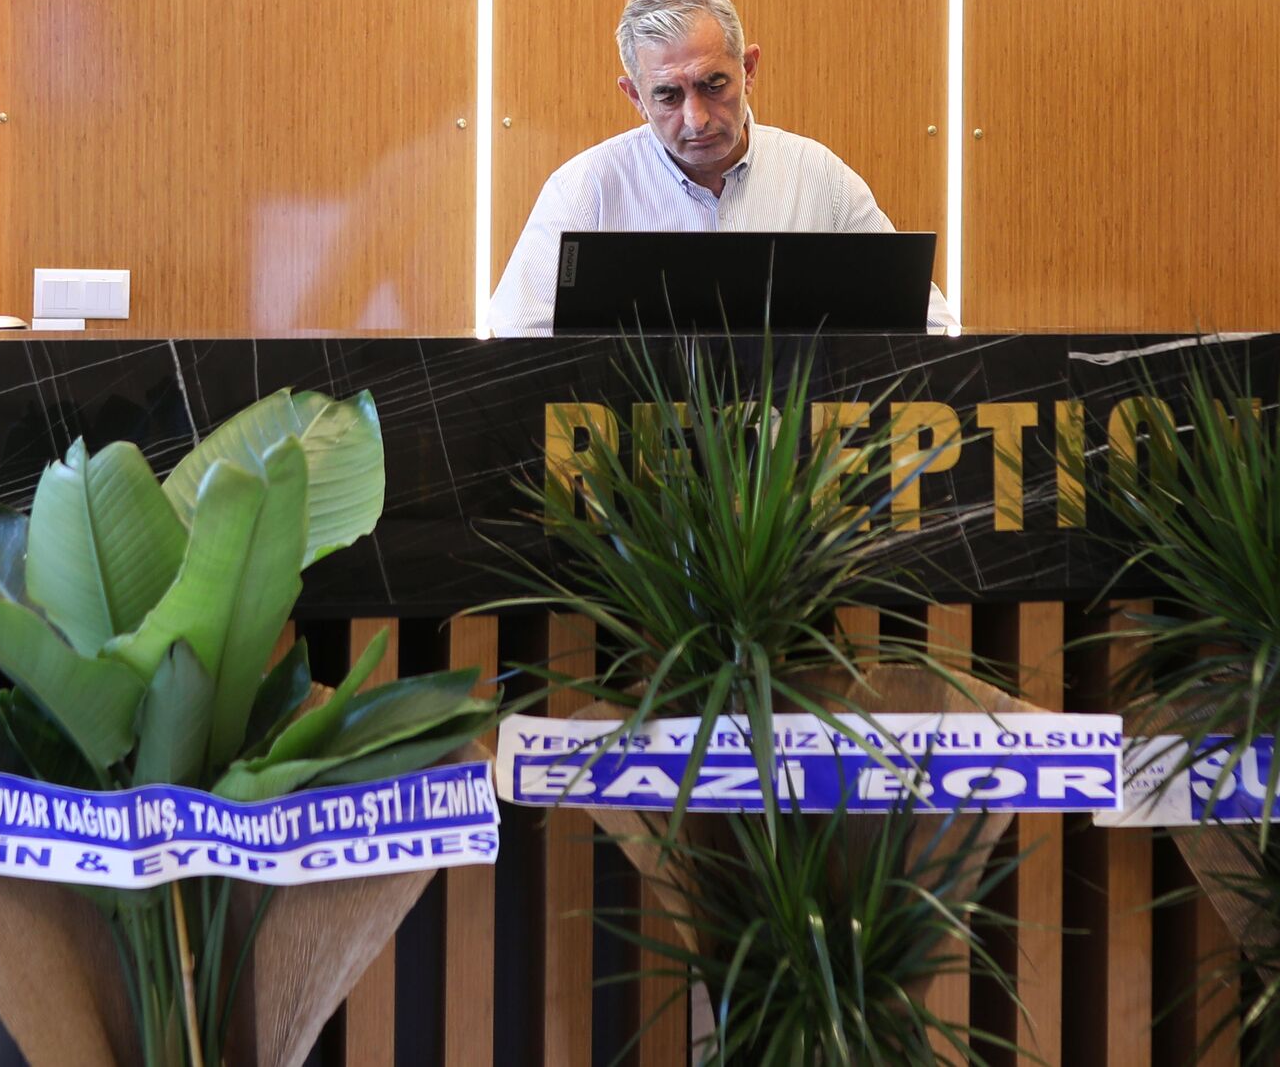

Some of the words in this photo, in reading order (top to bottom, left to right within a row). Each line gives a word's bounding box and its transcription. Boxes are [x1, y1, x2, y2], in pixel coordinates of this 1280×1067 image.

[563, 245, 576, 283] Lenovo
[833, 731, 982, 749] HAYIRLI
[996, 731, 1122, 749] OLSUN
[520, 760, 806, 800] BAZİ
[857, 766, 1117, 801] BOR
[52, 796, 130, 841] KAĞIDI
[189, 800, 302, 847] TAAHHÜT
[422, 770, 494, 820] İZMİR
[75, 851, 110, 874] &
[133, 843, 277, 877] EYÜP
[300, 830, 497, 870] GÜNEŞ
